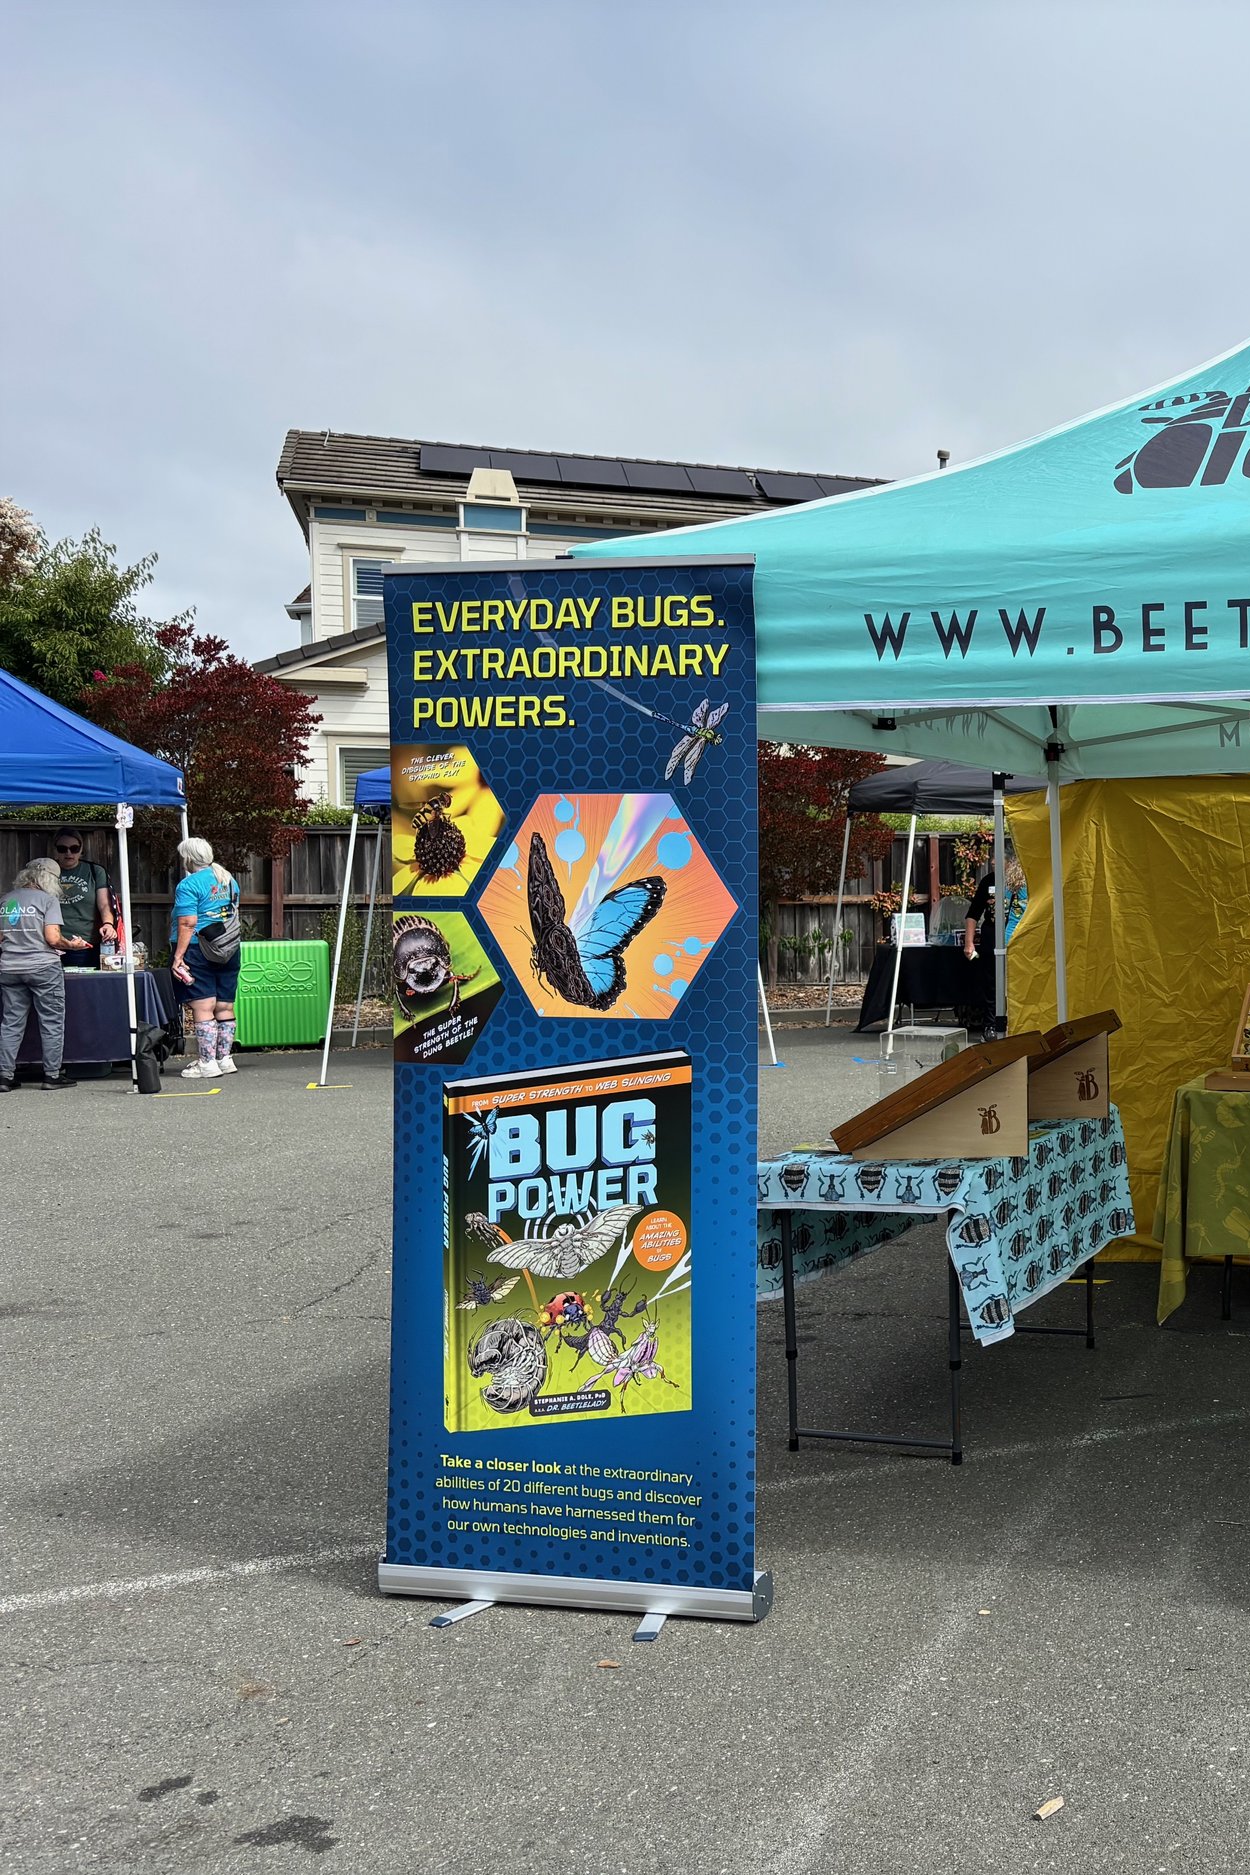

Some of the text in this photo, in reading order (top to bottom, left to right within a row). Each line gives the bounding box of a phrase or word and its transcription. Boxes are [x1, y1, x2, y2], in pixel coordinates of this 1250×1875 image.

[412, 595, 725, 634] EVERYDAY BUGS.
[413, 643, 729, 681] EXTRAORDINARY
[413, 695, 576, 729] POWERS.
[401, 760, 466, 775] DISGUISE OF THE
[411, 752, 455, 765] THE CLEVER
[0, 906, 36, 914] OLANO
[414, 1016, 478, 1054] STRENGTH OF THE
[423, 1015, 461, 1040] THE SUPER
[422, 1027, 475, 1059] DUNG BEETLE!
[471, 1072, 672, 1107] FROM SUPER STRENGTH TO WEB SLINGING
[488, 1098, 656, 1180] BUG
[487, 1163, 658, 1224] POWER
[639, 1229, 680, 1241] AMAZING
[641, 1238, 682, 1249] ABILITIES
[647, 1253, 672, 1263] BUGS
[534, 1396, 568, 1405] STEPHANIE
[561, 1399, 607, 1411] BEETLELADY
[440, 1454, 693, 1486] Take a closer look at the extraordinary
[435, 1476, 702, 1507] abilities of 20 different bugs and discover
[442, 1497, 695, 1527] how humans have harnessed them for
[447, 1519, 691, 1548] our own technologies and inventions.
